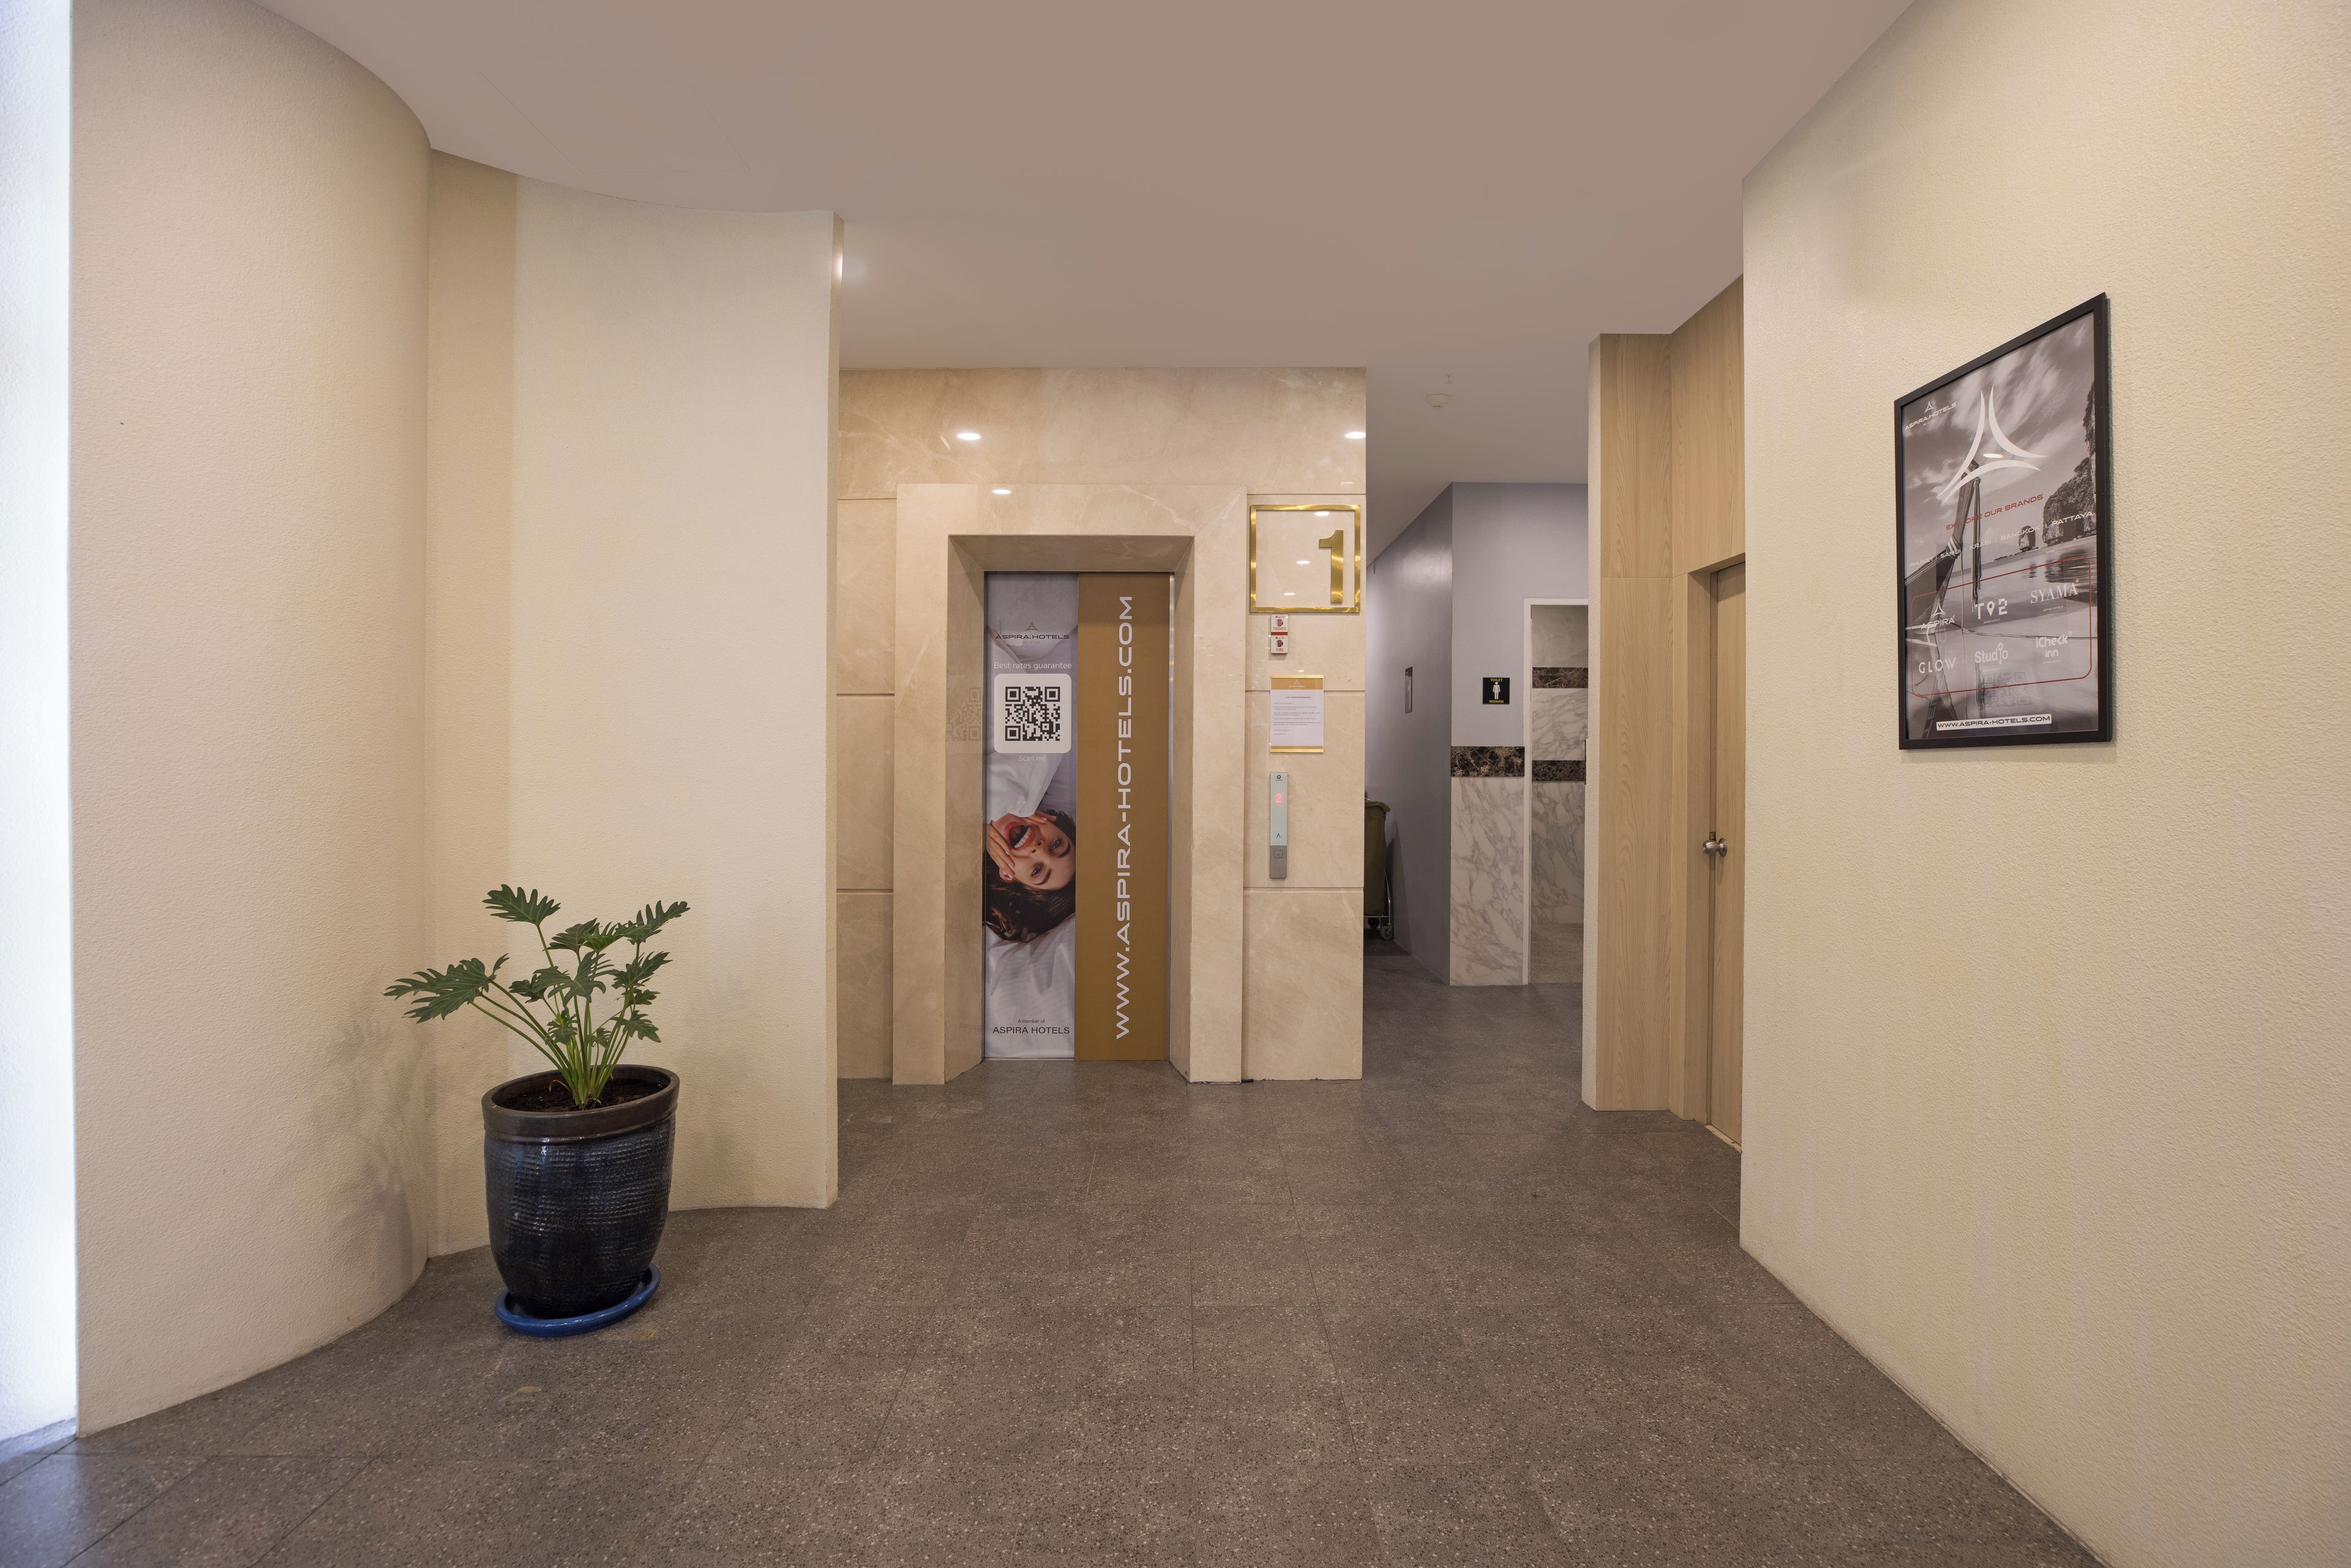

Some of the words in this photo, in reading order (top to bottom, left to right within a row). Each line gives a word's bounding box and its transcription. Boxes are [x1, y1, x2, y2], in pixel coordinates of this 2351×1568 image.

[1946, 514, 1982, 530] EXPLORE
[1984, 507, 2003, 517] OUR
[2004, 494, 2044, 511] BRANDS
[1909, 557, 1935, 568] PHUKET
[1970, 539, 1992, 550] KRABI
[2001, 525, 2041, 541] BANGKOK
[2052, 511, 2093, 527] PATTAYA
[1318, 529, 1344, 604] 1
[2030, 582, 2079, 604] SYAMA
[1918, 657, 1956, 673] GLOW
[2045, 650, 2059, 658] inn
[1938, 716, 2050, 728] WWW.ASPIRA-HOTELS.COM
[1116, 596, 1133, 1040] WWW.ASPIRA-HOTELS.COM
